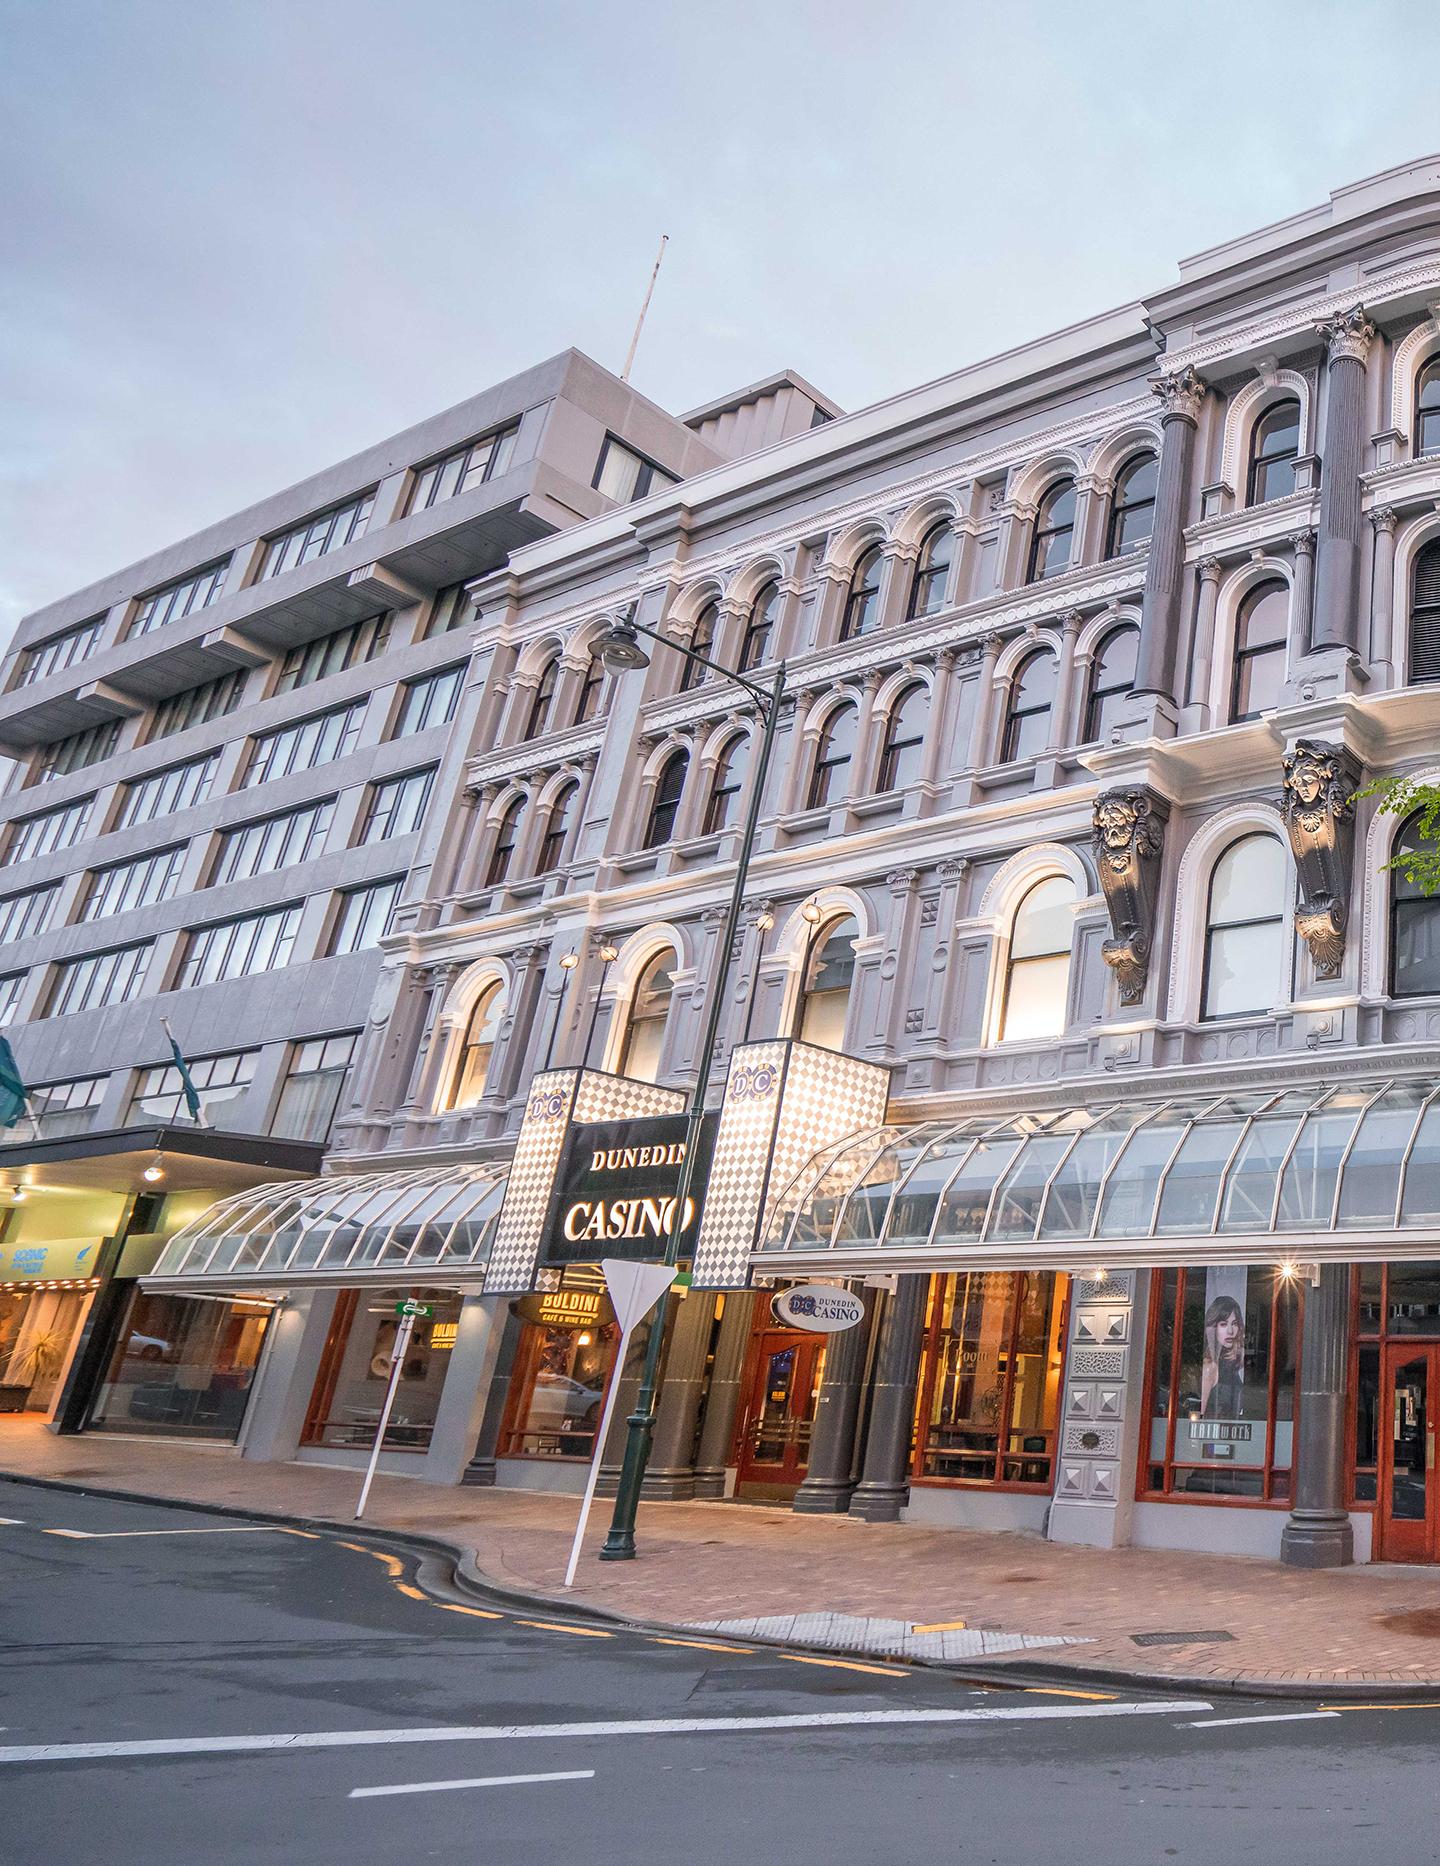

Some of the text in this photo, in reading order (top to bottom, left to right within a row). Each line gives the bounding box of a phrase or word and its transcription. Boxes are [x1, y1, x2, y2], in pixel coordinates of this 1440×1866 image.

[590, 1143, 687, 1171] DUNEDIN
[563, 1197, 695, 1242] CASINO
[813, 1306, 860, 1321] CASINO
[819, 1298, 857, 1308] DUNEDIN
